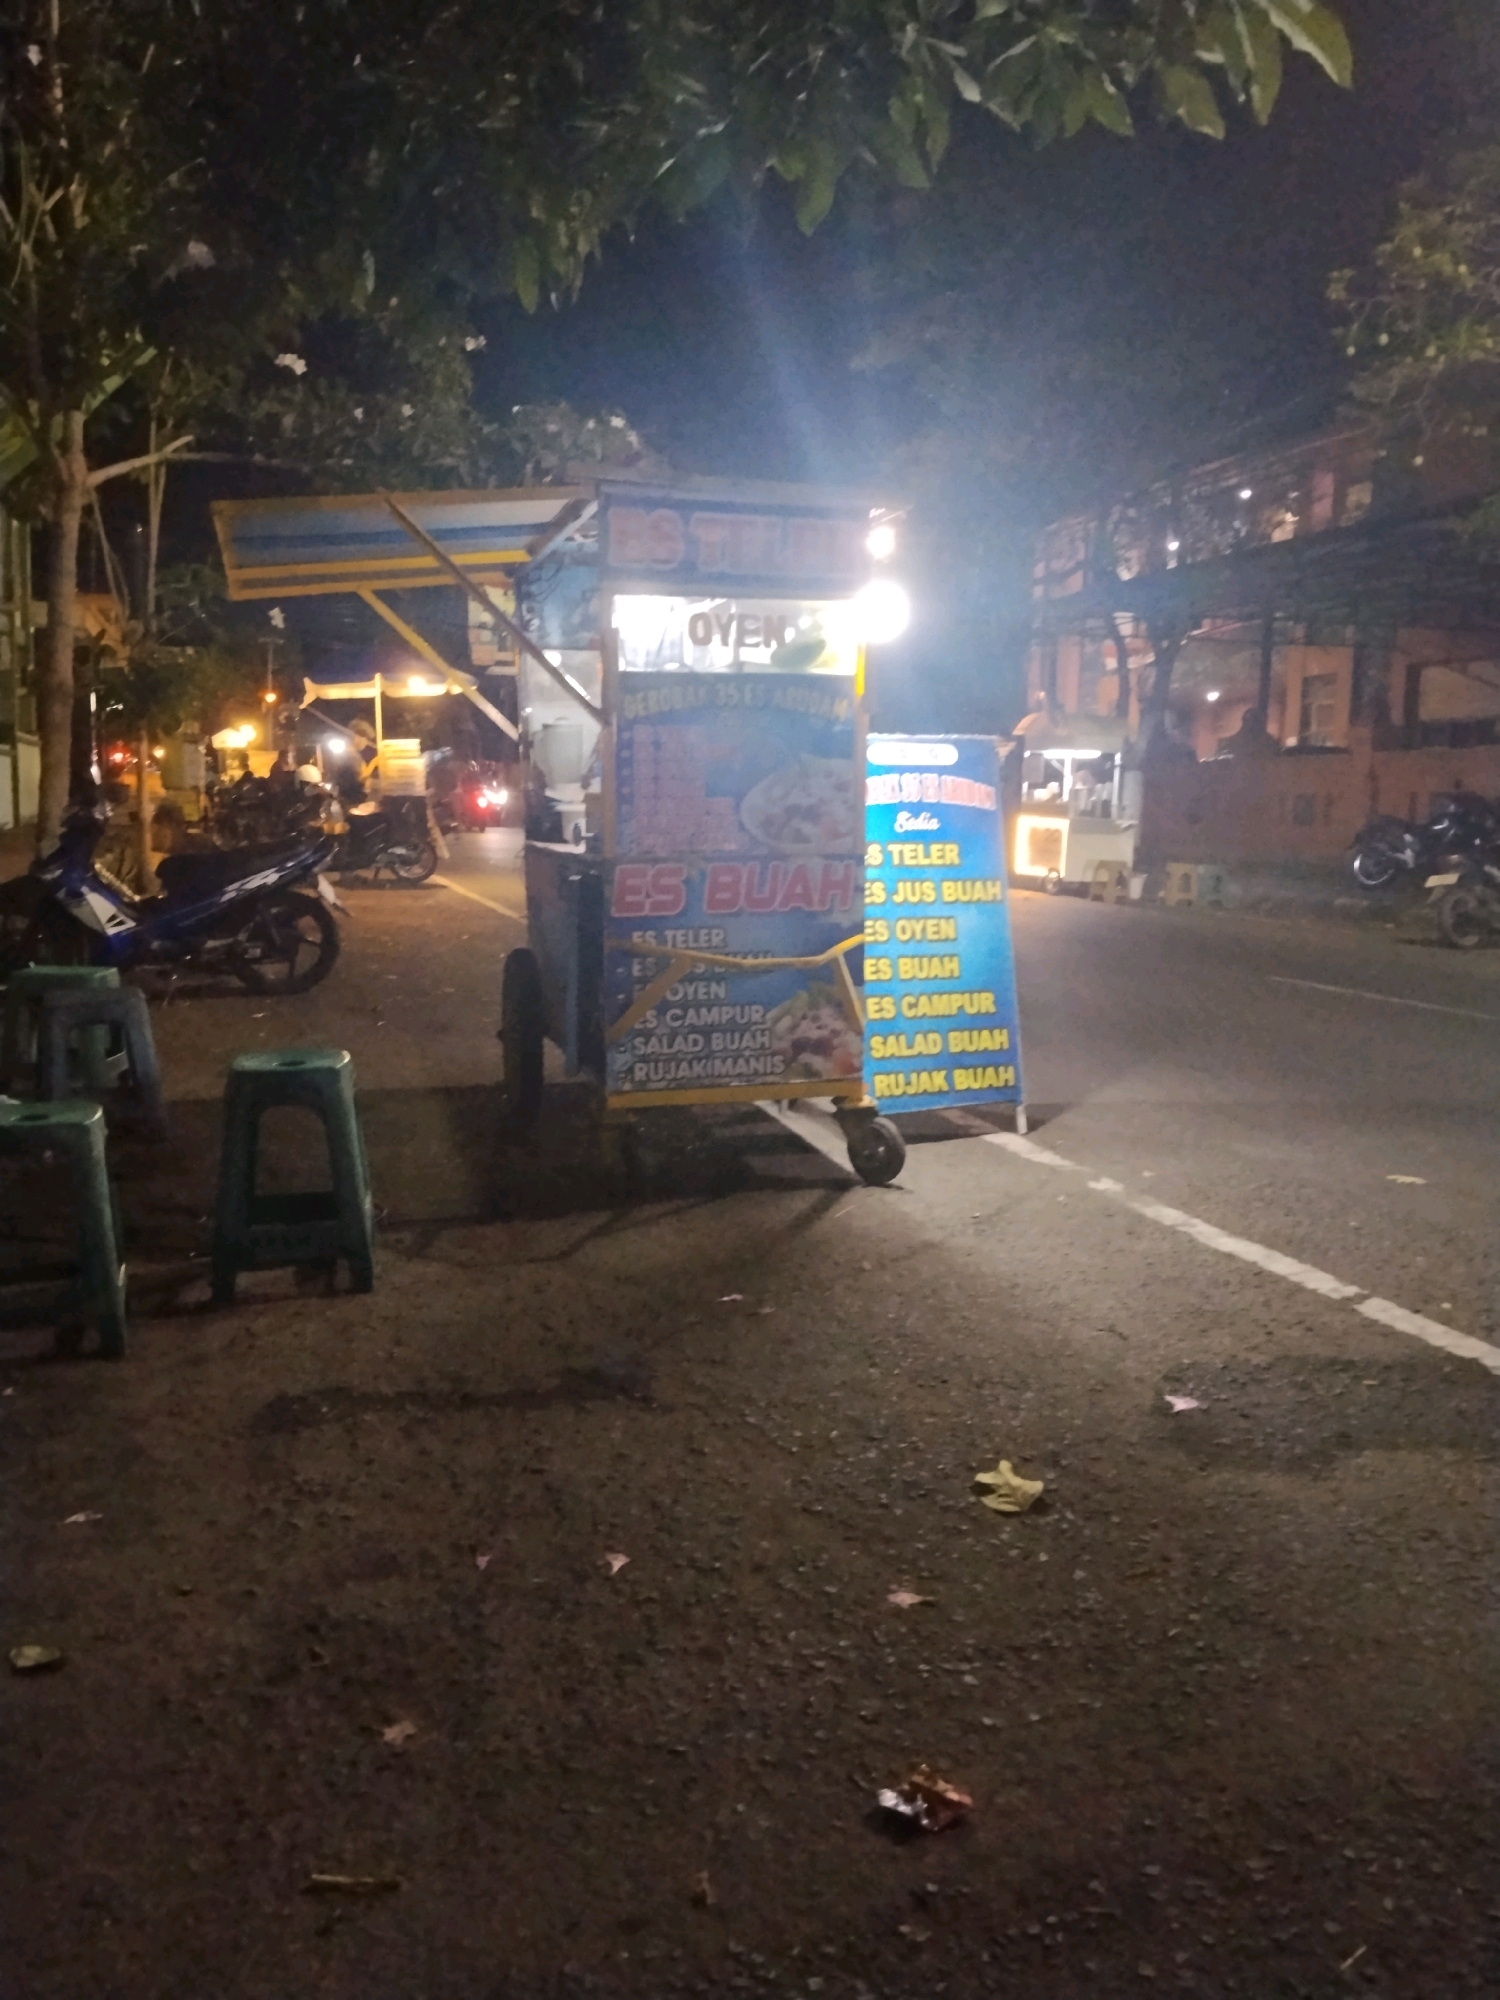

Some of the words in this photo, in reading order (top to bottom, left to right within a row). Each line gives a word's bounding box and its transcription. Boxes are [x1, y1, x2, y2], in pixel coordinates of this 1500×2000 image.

[688, 611, 787, 648] OYEN
[894, 811, 941, 832] Sedia
[887, 843, 960, 867] TELER
[611, 863, 687, 917] ES
[703, 861, 855, 915] BUAH
[892, 880, 936, 904] JUS
[941, 880, 1002, 903] BUAH
[664, 928, 725, 949] TELER
[864, 919, 889, 942] ES
[895, 917, 956, 941] OYEN
[632, 957, 657, 977] ES
[863, 957, 892, 981] ES
[898, 955, 960, 980] BUAH
[666, 980, 727, 1001] OYEN
[666, 1005, 764, 1028] CAMPUR
[866, 996, 896, 1020] ES
[901, 991, 996, 1019] CAMPUR
[633, 1032, 705, 1055] SALAD
[712, 1030, 771, 1051] BUAH
[869, 1031, 943, 1060] SALAD
[948, 1028, 1010, 1054] BUAH
[713, 1054, 786, 1077] MANIS
[873, 1069, 949, 1098] RUJAK
[953, 1065, 1015, 1091] BUAH
